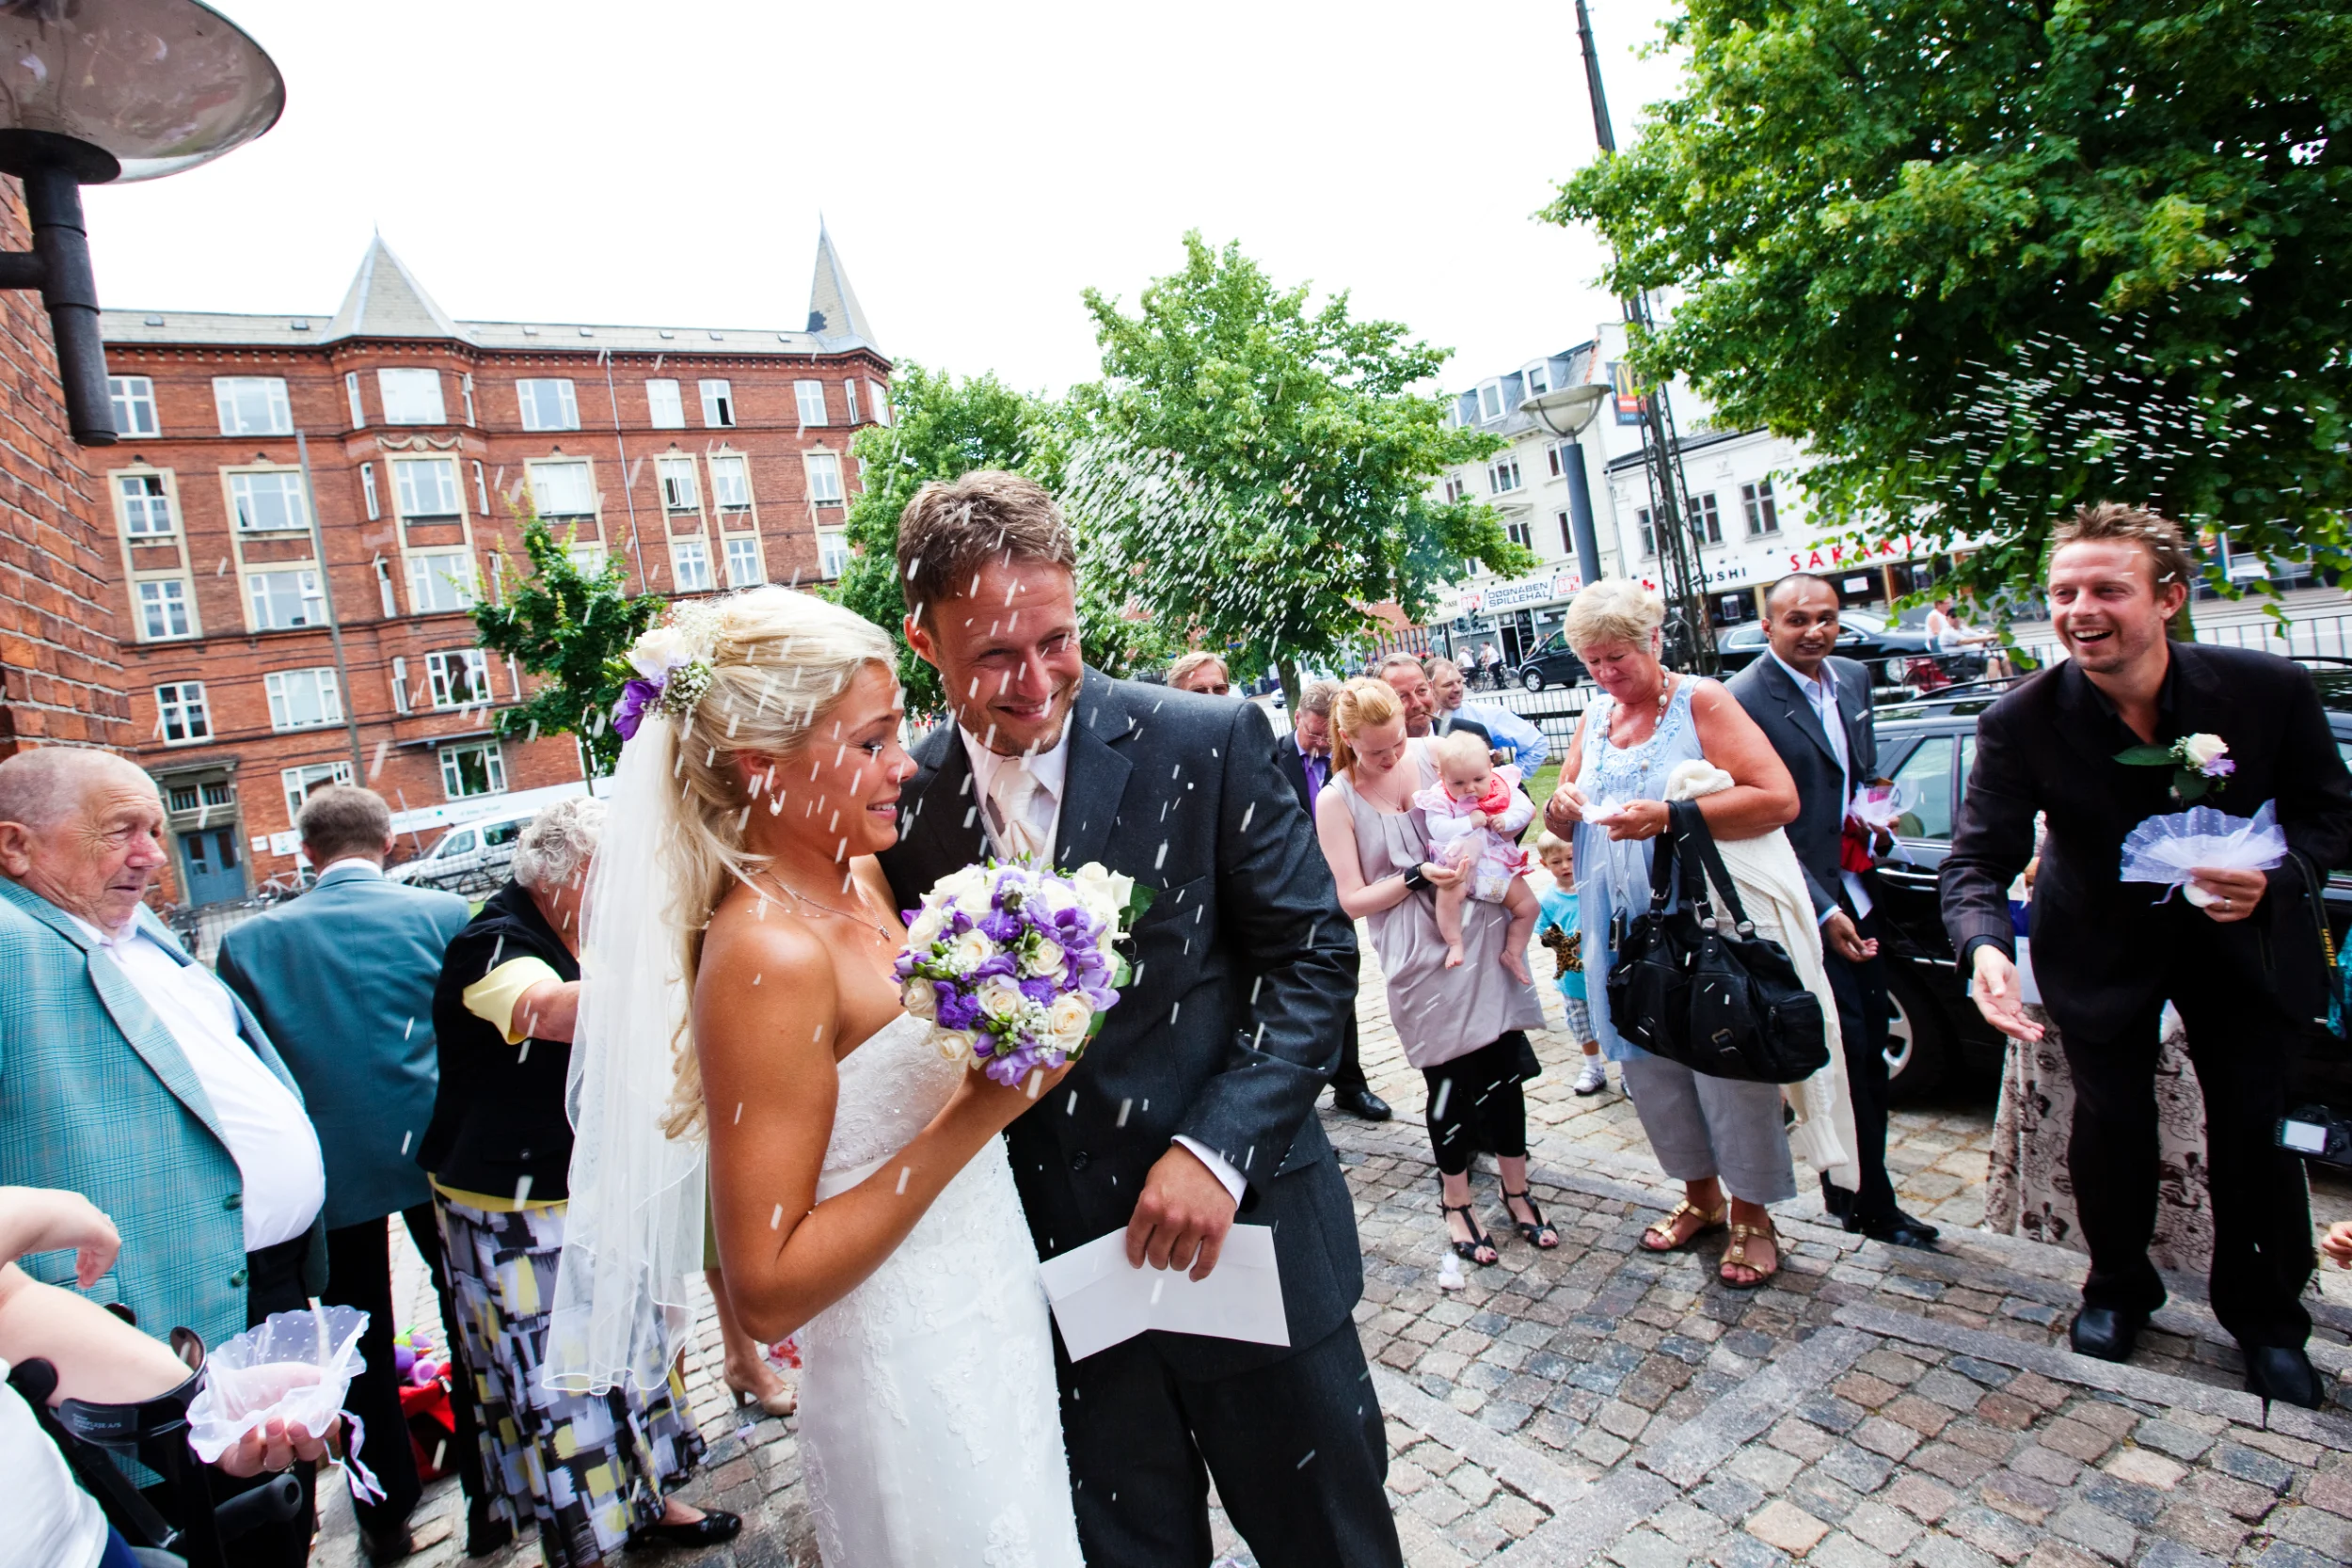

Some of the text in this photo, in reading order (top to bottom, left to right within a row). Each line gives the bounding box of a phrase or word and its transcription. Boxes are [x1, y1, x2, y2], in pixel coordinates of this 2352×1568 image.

[1487, 581, 1549, 599] DØGNÅBEN
[1488, 591, 1549, 608] SPILLEHAL
[2321, 928, 2338, 967] Nikon
